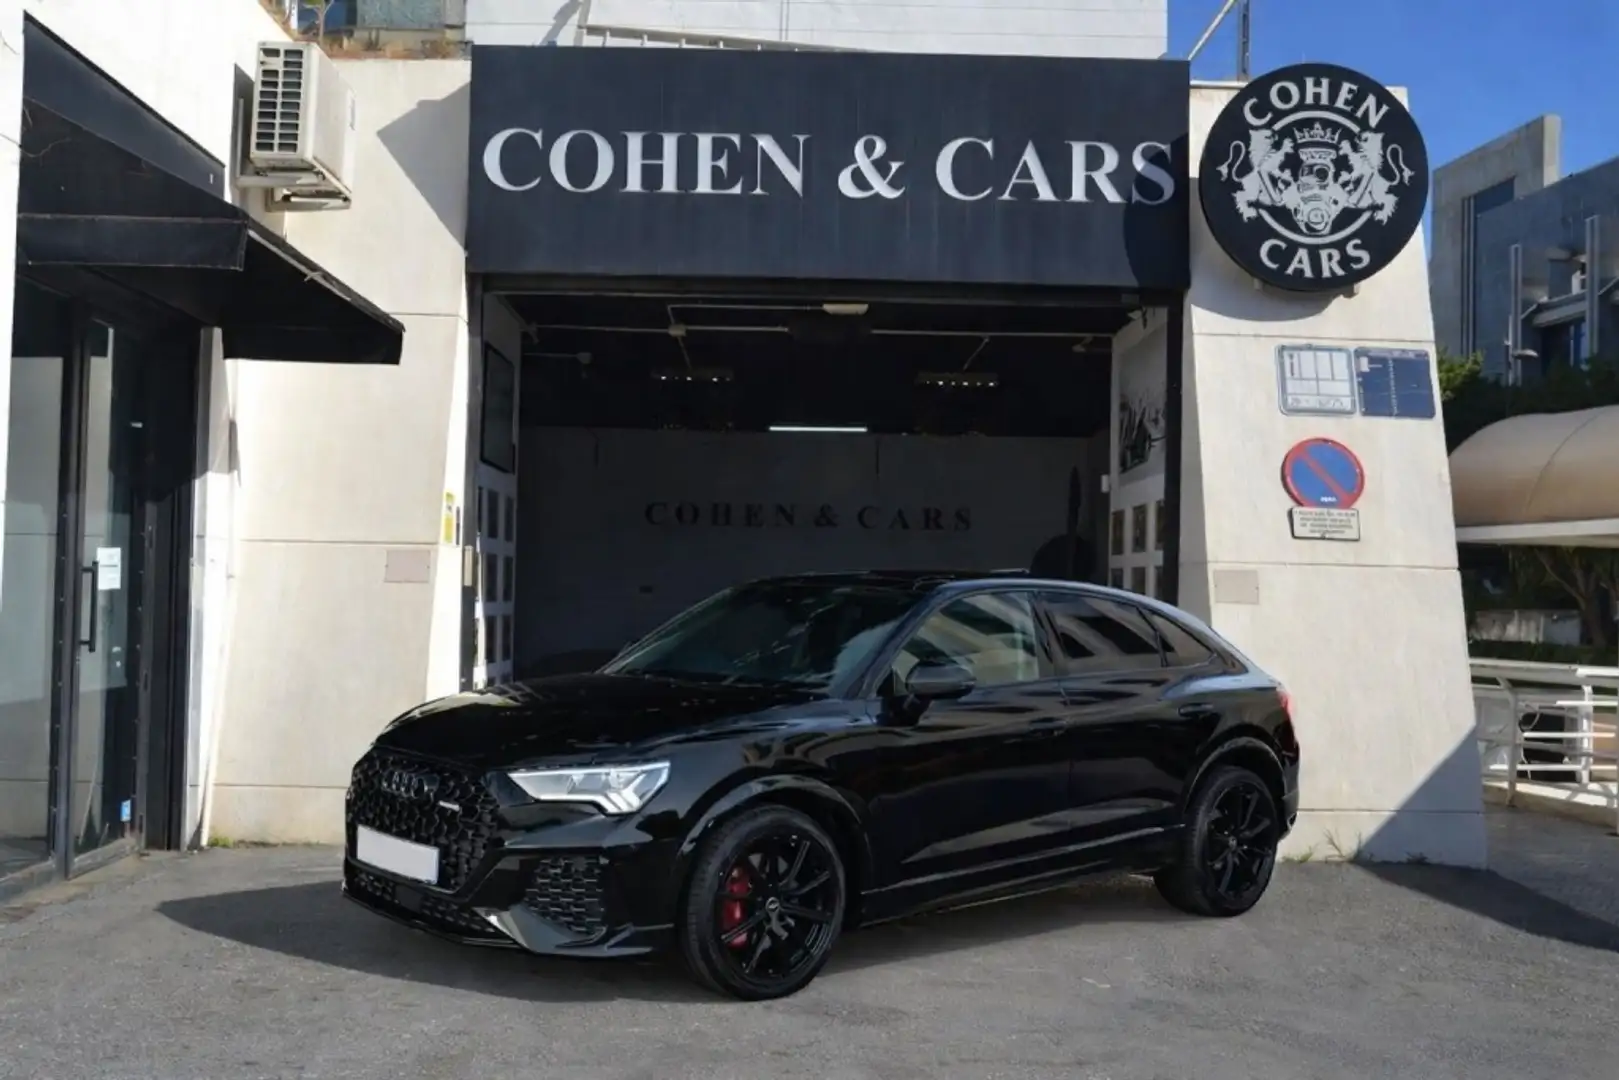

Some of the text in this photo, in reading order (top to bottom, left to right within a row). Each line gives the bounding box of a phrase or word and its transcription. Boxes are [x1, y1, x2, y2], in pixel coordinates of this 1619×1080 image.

[1243, 76, 1390, 128] COHEN
[483, 127, 1175, 205] COHEN & CARS
[1259, 238, 1371, 279] CARS
[644, 501, 972, 531] COHEN & CARS
